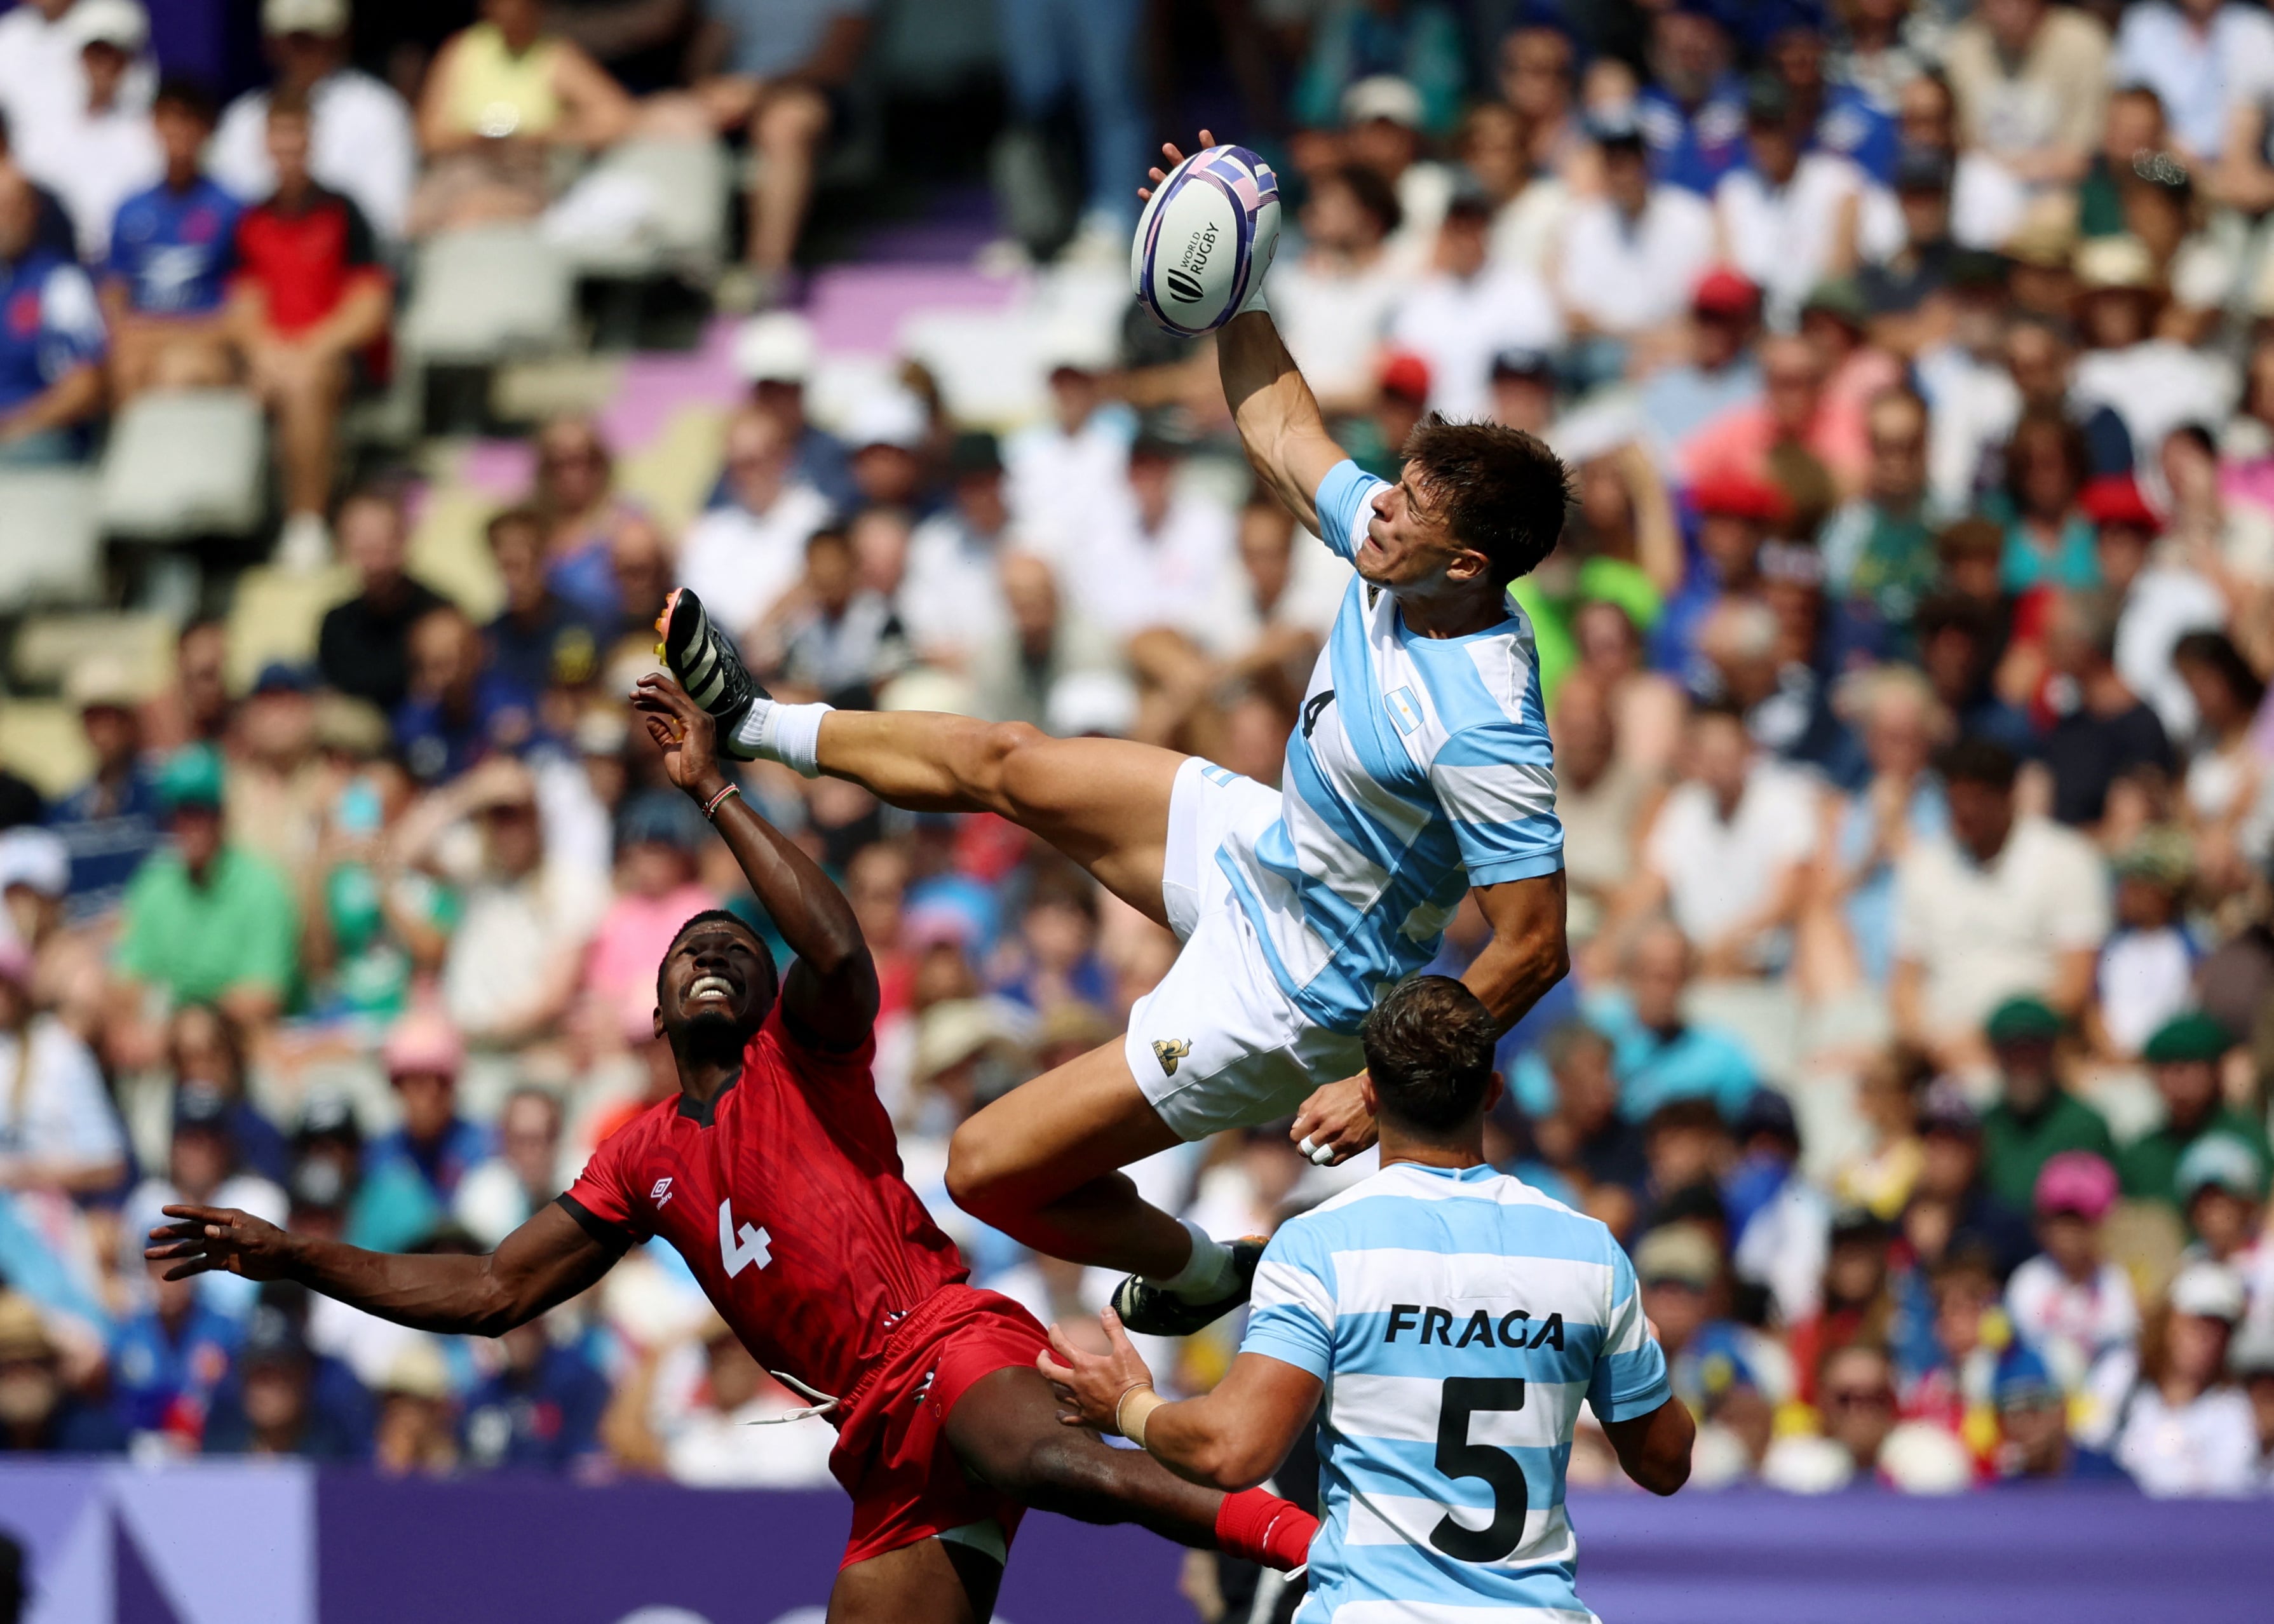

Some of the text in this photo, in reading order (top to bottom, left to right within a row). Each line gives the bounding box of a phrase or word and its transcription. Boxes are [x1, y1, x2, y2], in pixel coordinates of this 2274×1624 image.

[1180, 232, 1200, 267] WORLD
[1190, 221, 1219, 275] RUGBY
[1303, 689, 1335, 741] 4
[719, 1197, 773, 1280] 4
[1384, 1304, 1564, 1352] FRAGA
[1428, 1376, 1528, 1562] 5
